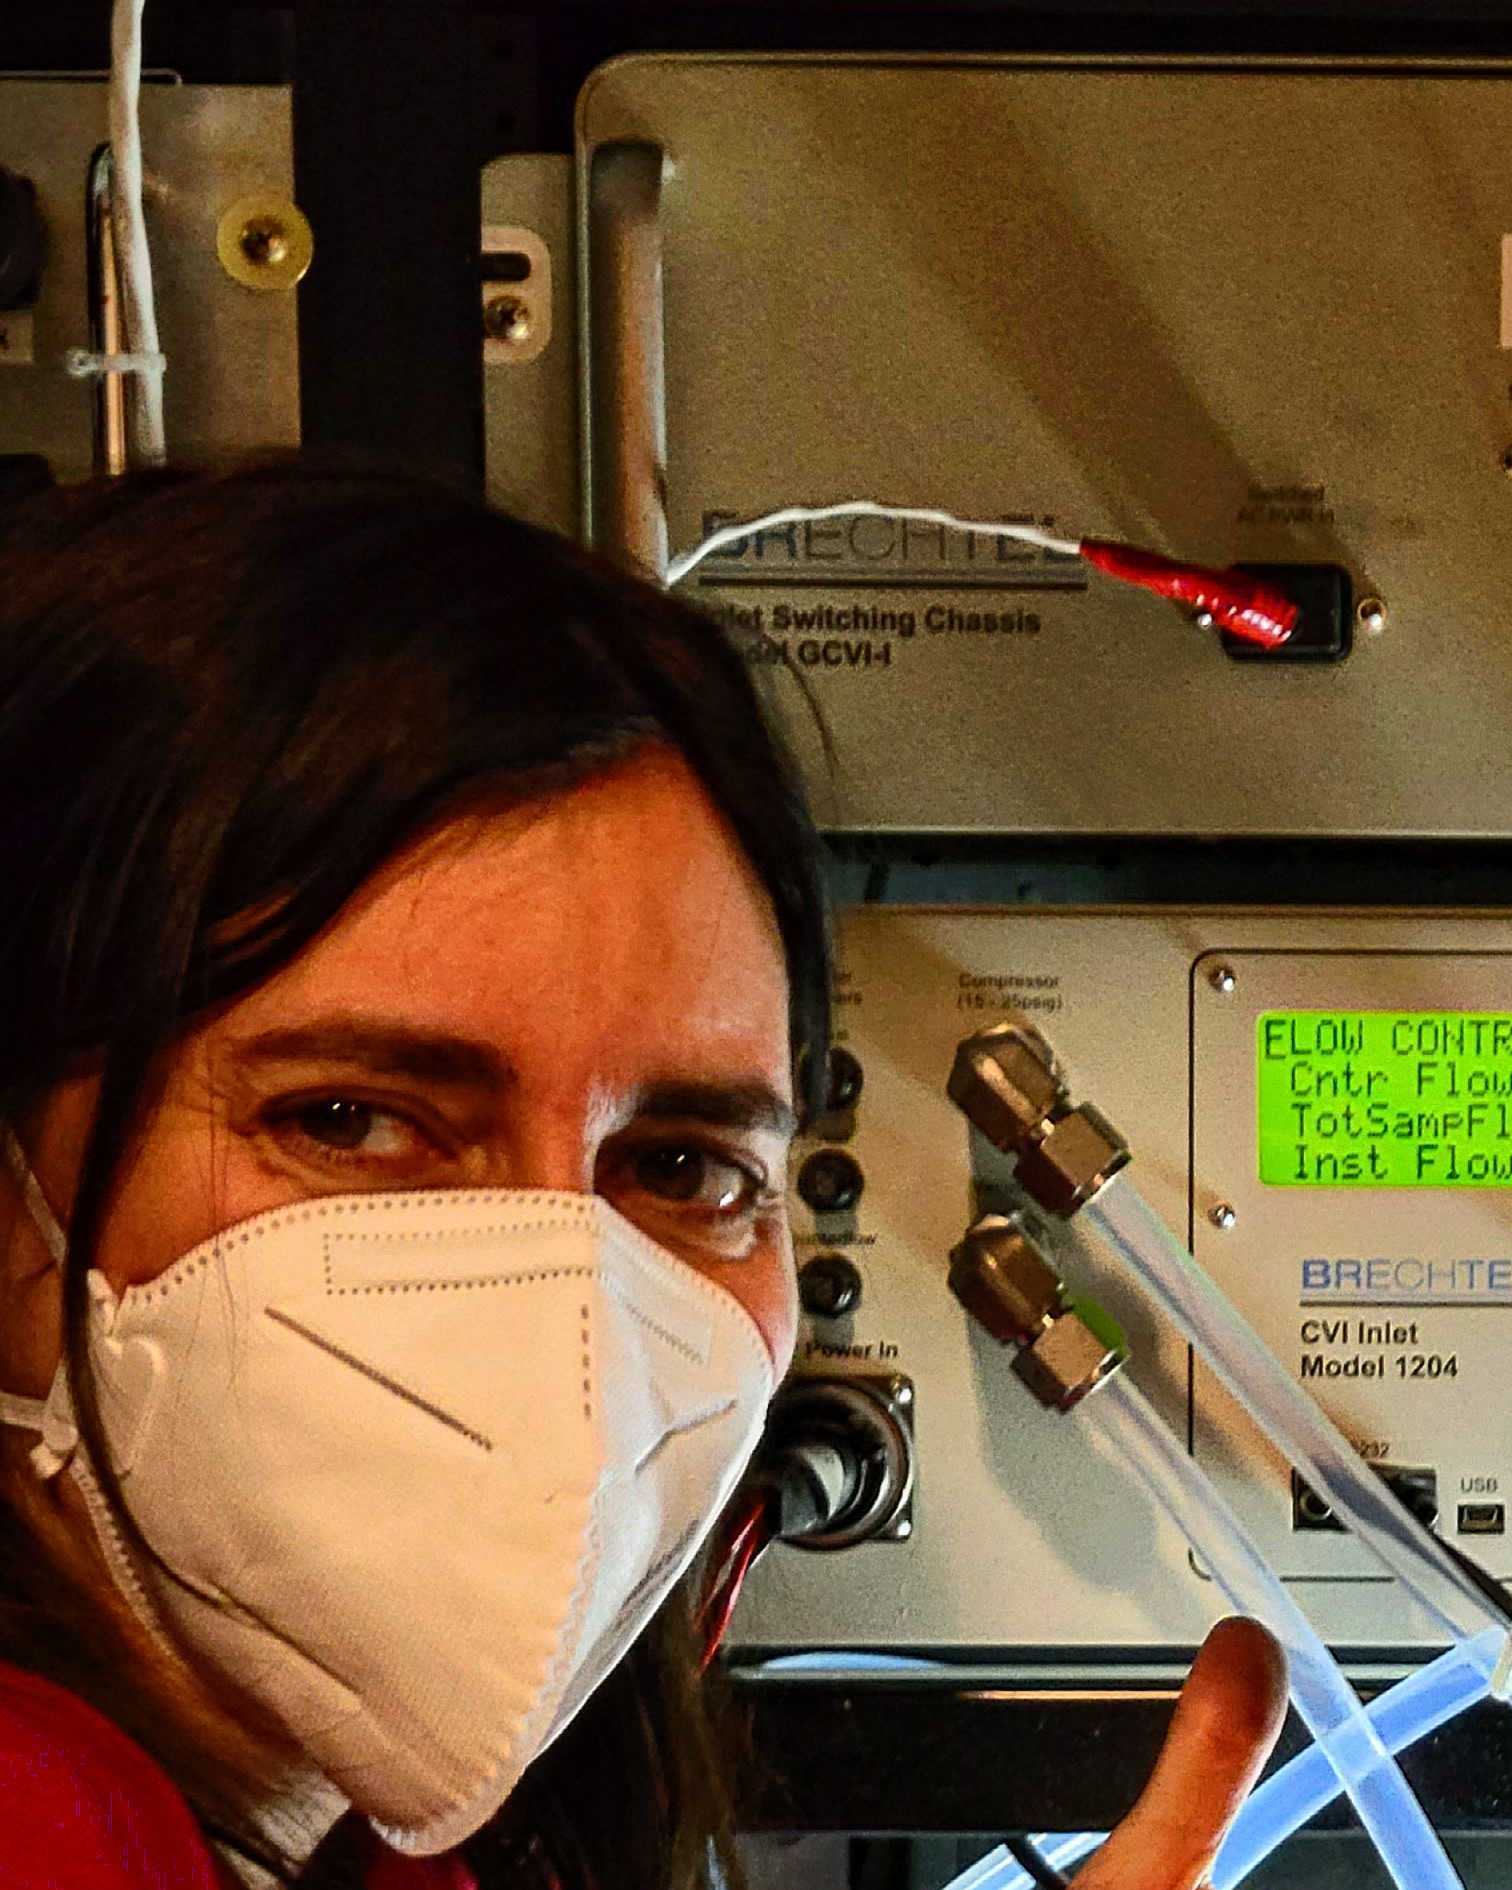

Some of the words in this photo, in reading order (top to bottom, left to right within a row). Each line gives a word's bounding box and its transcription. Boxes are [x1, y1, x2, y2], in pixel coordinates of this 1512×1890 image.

[772, 603, 917, 637] Switching
[924, 605, 1042, 634] Chassis
[1289, 1062, 1390, 1098] Cntr
[1291, 1144, 1390, 1181] Inst
[1300, 1320, 1349, 1346] CVI
[1358, 1320, 1419, 1346] Inlet
[805, 1341, 873, 1360] Power
[879, 1340, 899, 1360] In
[1300, 1353, 1384, 1379] Model
[1396, 1354, 1459, 1379] 1204
[1358, 1440, 1390, 1459] 232
[1459, 1476, 1499, 1494] USB
